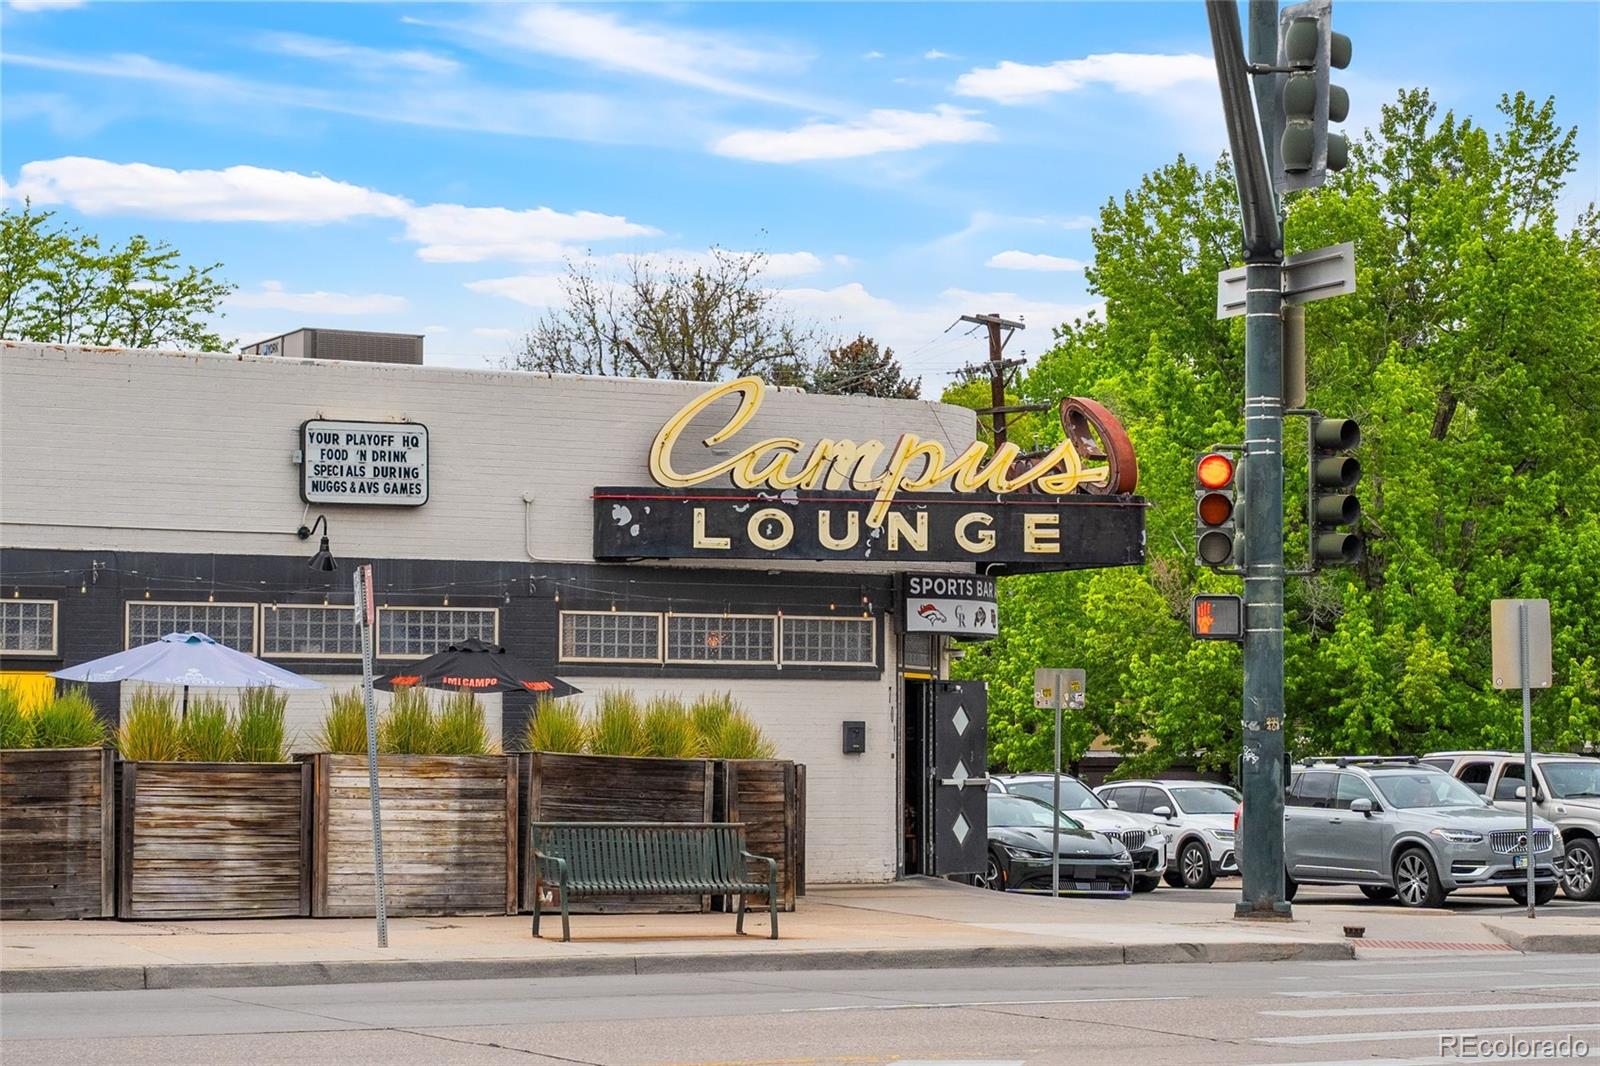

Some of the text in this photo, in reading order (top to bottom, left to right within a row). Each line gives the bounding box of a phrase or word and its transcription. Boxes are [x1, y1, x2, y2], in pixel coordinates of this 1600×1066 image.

[308, 431, 419, 448] YOUR PLAYOFF HQ
[320, 448, 349, 461] FOOD
[371, 450, 407, 463] DRINK
[648, 376, 1110, 528] Campus
[313, 464, 419, 479] SPECIALS DURING
[311, 480, 348, 493] NUGGS
[358, 481, 380, 495] AVS
[383, 482, 422, 495] GAMES
[692, 506, 1061, 554] LOUNGE
[909, 577, 974, 597] SPORTS
[976, 580, 994, 598] BAR
